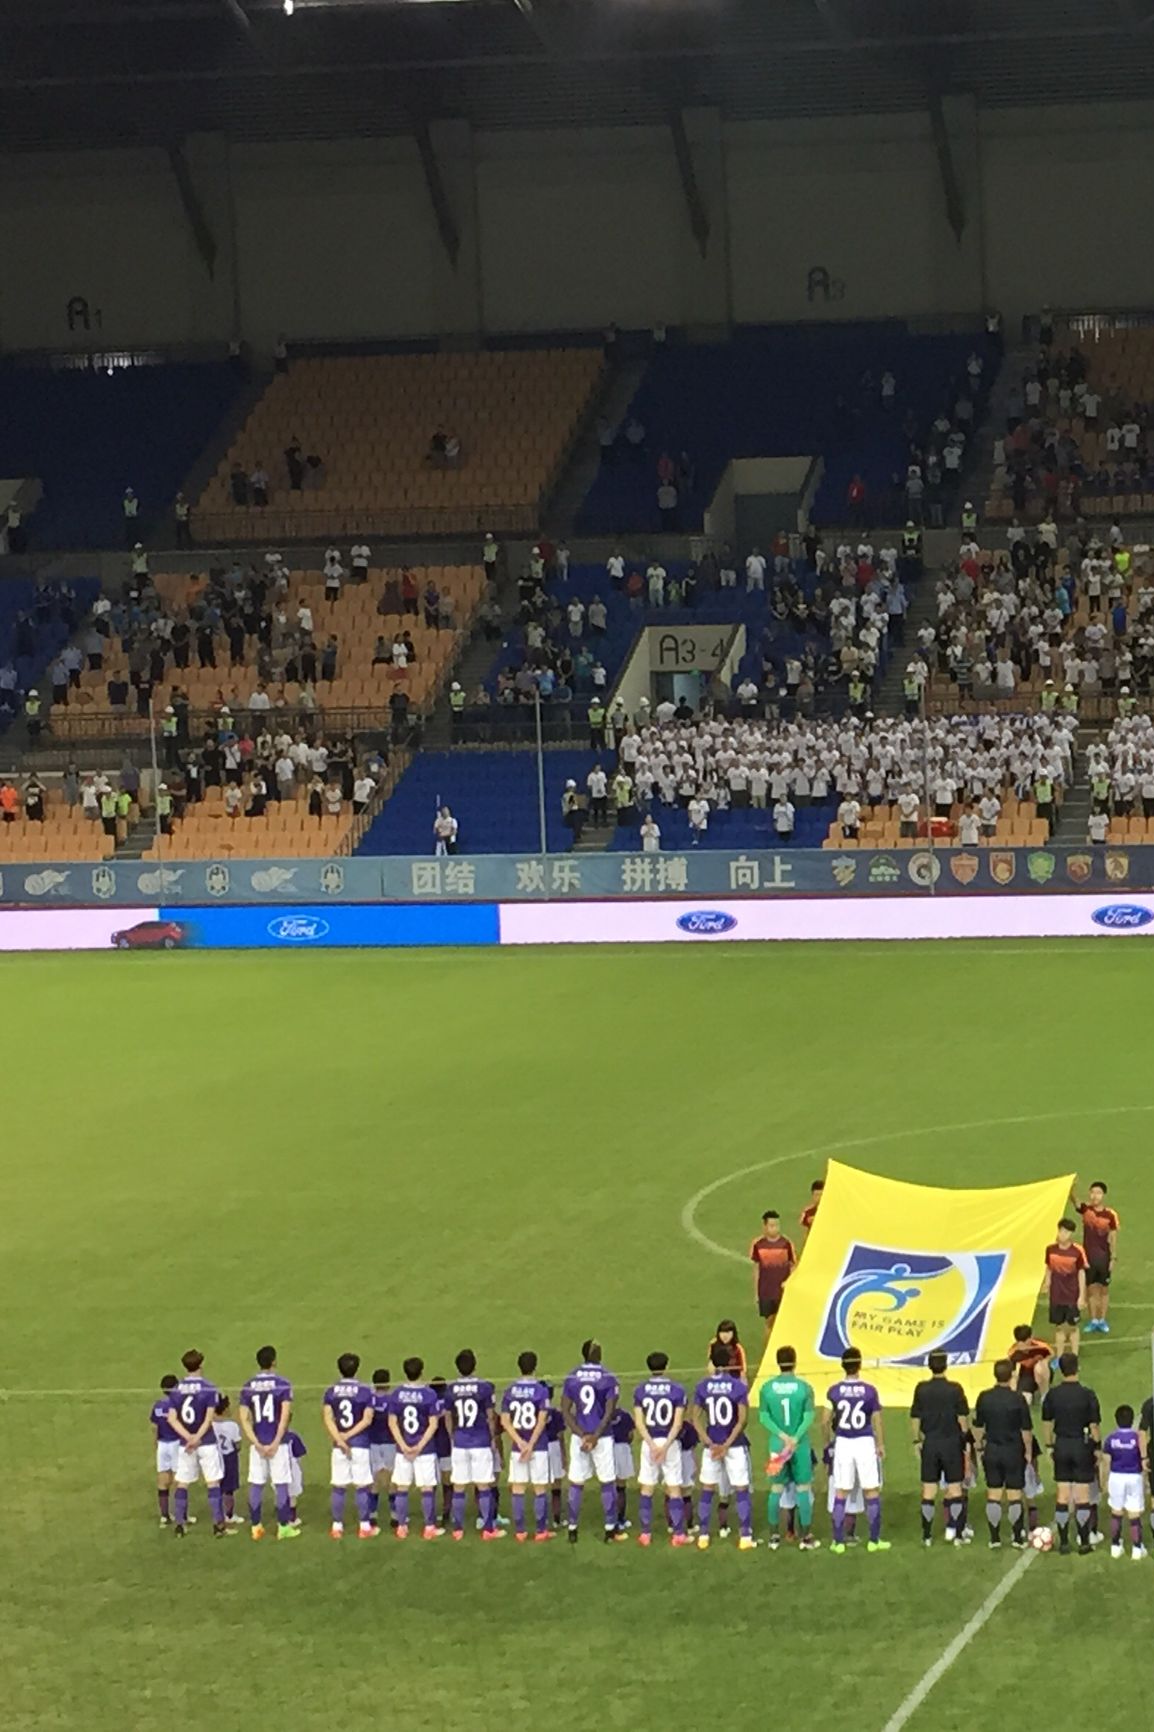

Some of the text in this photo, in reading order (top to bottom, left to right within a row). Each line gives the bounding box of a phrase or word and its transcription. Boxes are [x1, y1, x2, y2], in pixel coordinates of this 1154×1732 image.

[659, 633, 726, 666] A3-4
[411, 854, 796, 896] 团结 欢乐 拼搏 向上
[279, 919, 318, 937] Ford
[688, 914, 726, 931] Ford
[1103, 907, 1143, 925] Ford
[851, 1320, 925, 1338] FAIR PLAY
[853, 1311, 946, 1329] MY GAME IS
[181, 1395, 196, 1425] 6
[251, 1394, 275, 1424] 14
[339, 1399, 354, 1429] 3
[454, 1398, 479, 1428] 19
[579, 1384, 596, 1415] 9
[642, 1397, 673, 1427] 20
[705, 1396, 733, 1426] 10
[780, 1397, 791, 1427] 1
[403, 1405, 420, 1435] 8
[509, 1401, 537, 1430] 28
[837, 1400, 867, 1430] 26
